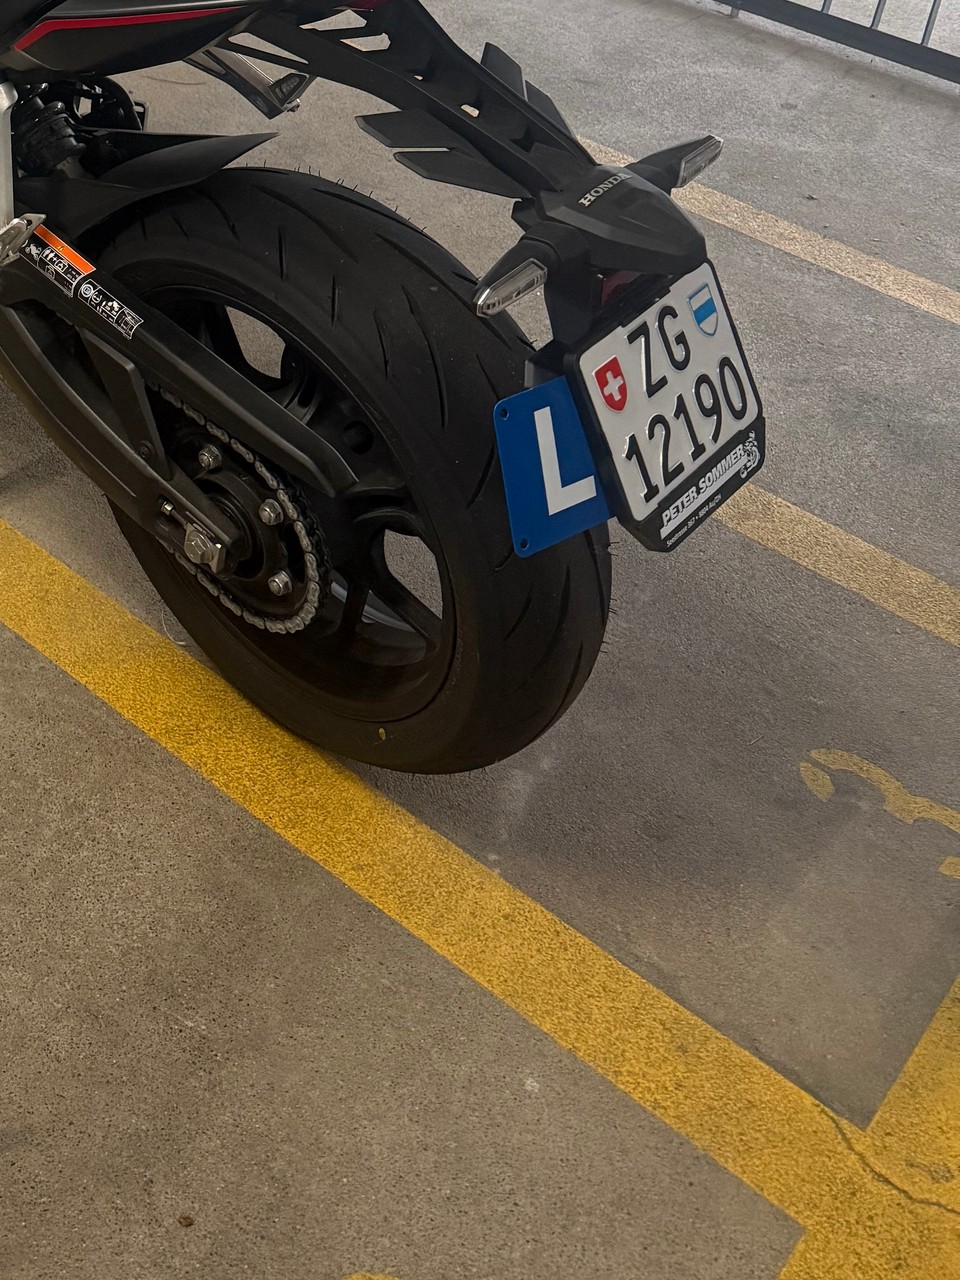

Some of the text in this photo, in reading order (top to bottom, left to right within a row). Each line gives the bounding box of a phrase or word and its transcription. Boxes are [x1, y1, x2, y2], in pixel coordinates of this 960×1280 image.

[578, 173, 632, 207] HONDA
[626, 305, 690, 399] ZG
[533, 406, 597, 516] L
[624, 356, 748, 504] 12190
[661, 443, 745, 527] PETER SOMMER
